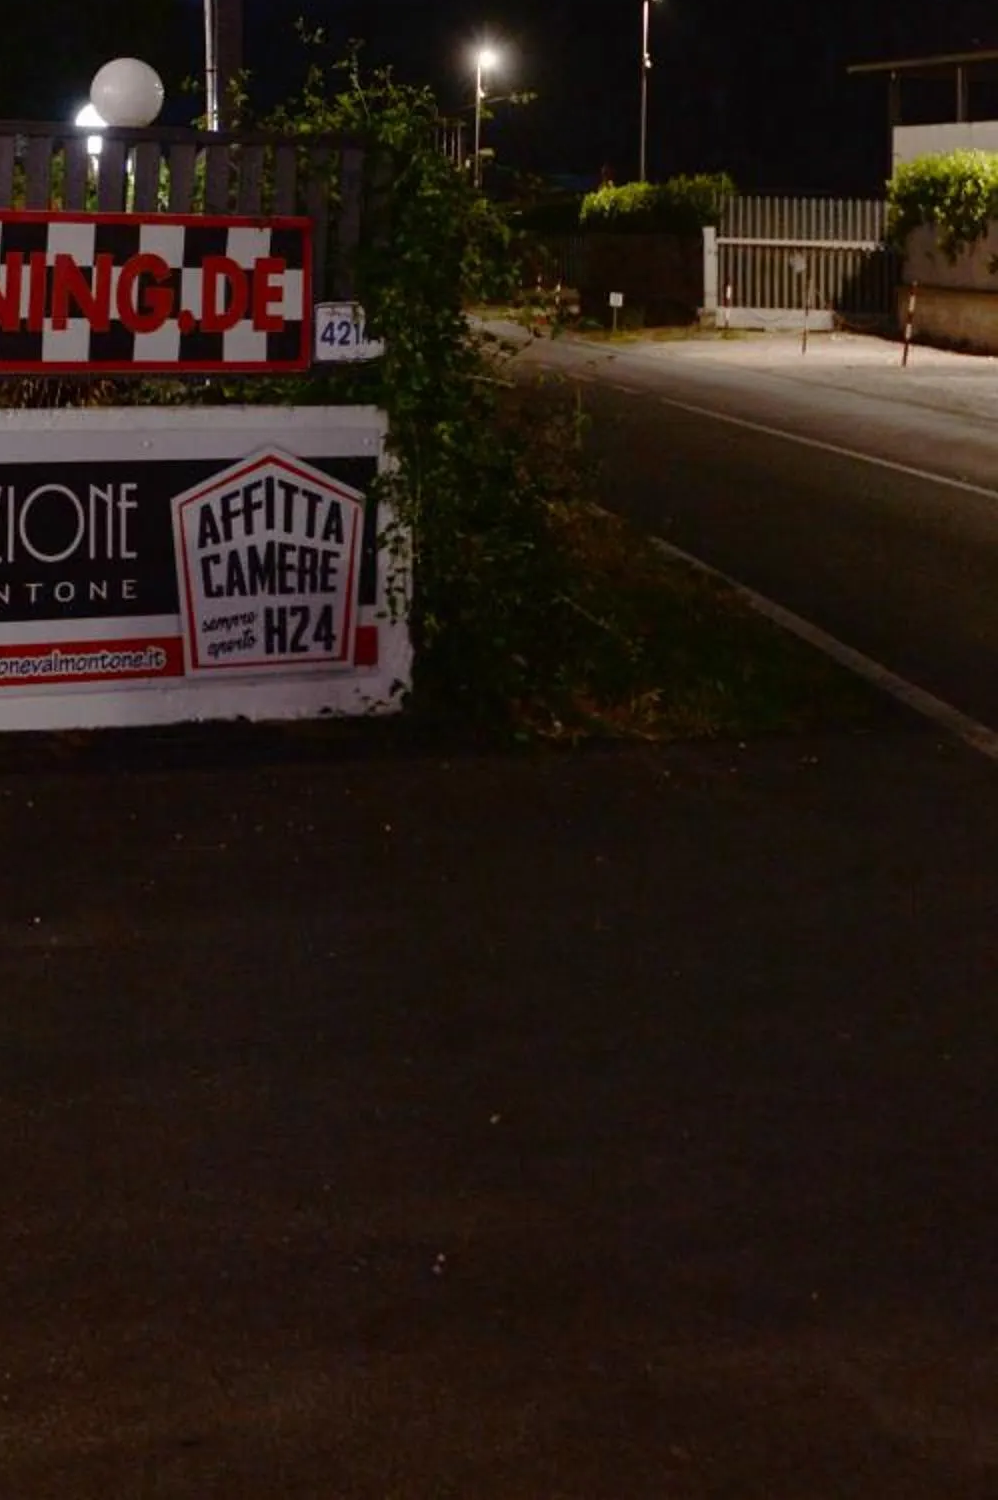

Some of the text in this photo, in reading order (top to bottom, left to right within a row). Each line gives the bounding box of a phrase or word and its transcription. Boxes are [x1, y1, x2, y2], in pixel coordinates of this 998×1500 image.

[198, 476, 344, 548] AFFITTA
[200, 540, 340, 598] CAMERE
[264, 604, 336, 655] H24
